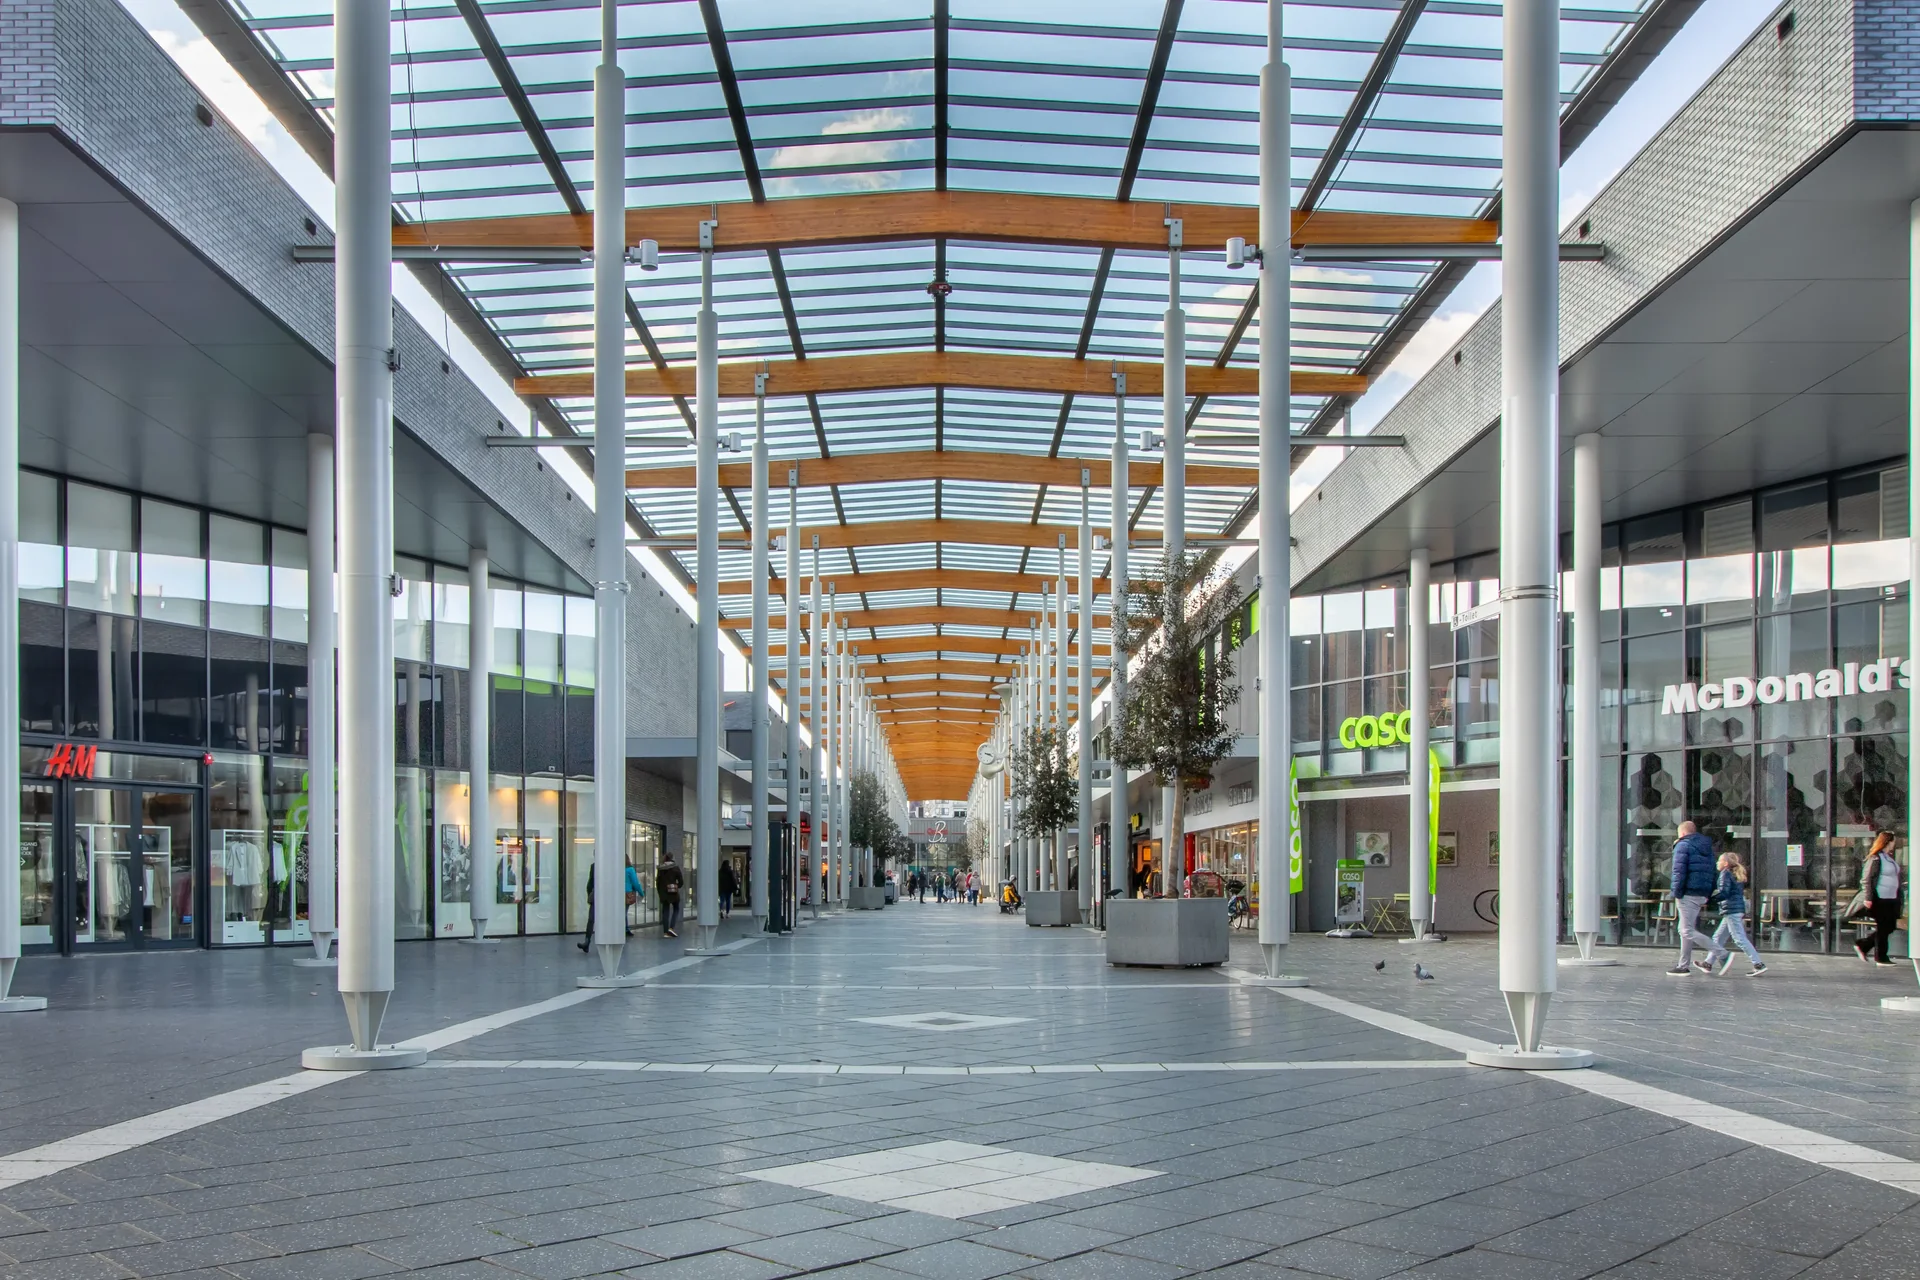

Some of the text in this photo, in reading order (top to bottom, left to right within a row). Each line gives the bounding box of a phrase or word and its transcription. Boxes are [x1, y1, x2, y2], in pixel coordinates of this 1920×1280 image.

[1661, 657, 1911, 715] McDonald's
[1339, 710, 1411, 749] casa
[47, 743, 98, 779] H&M
[1342, 872, 1360, 881] casa
